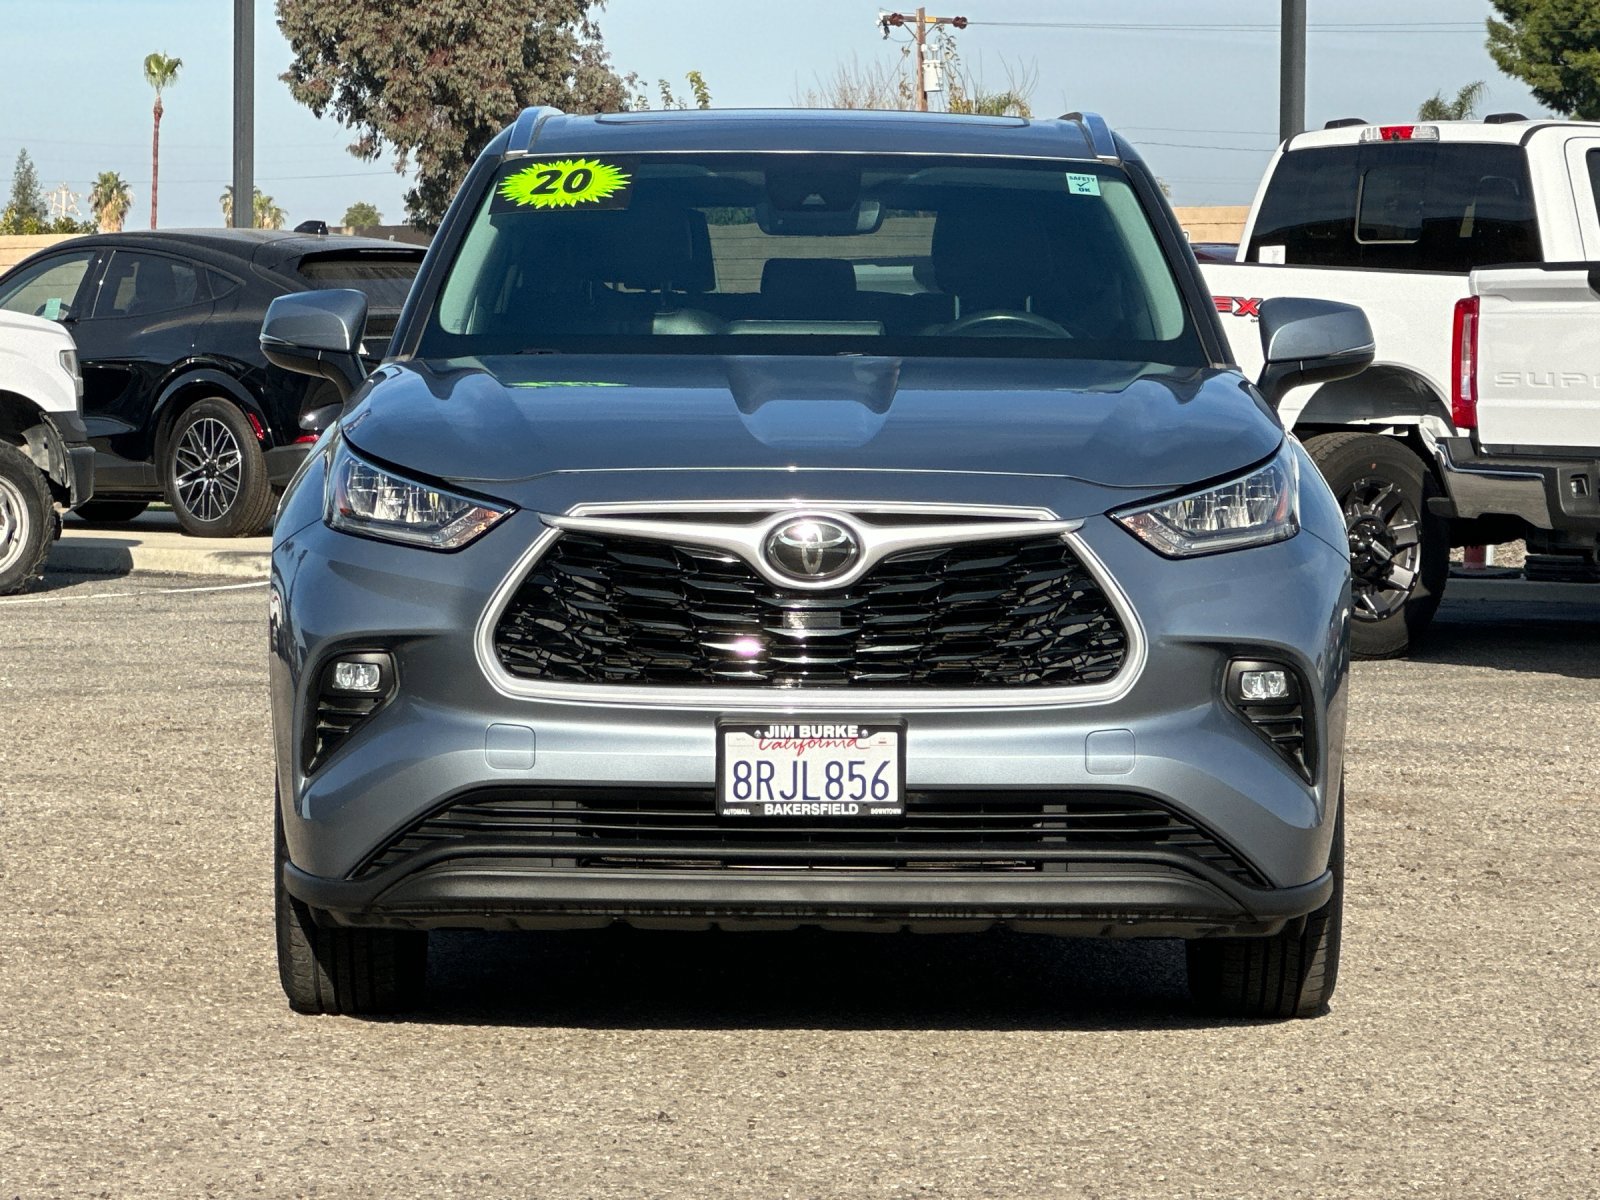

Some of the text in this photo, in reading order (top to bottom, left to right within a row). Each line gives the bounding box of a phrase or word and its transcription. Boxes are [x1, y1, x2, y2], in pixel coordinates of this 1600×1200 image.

[529, 168, 593, 195] 20
[1494, 371, 1600, 389] SUP
[764, 725, 859, 739] JIM BURKE
[732, 759, 891, 801] 8RJL856
[764, 803, 859, 816] BAKERSFIELD
